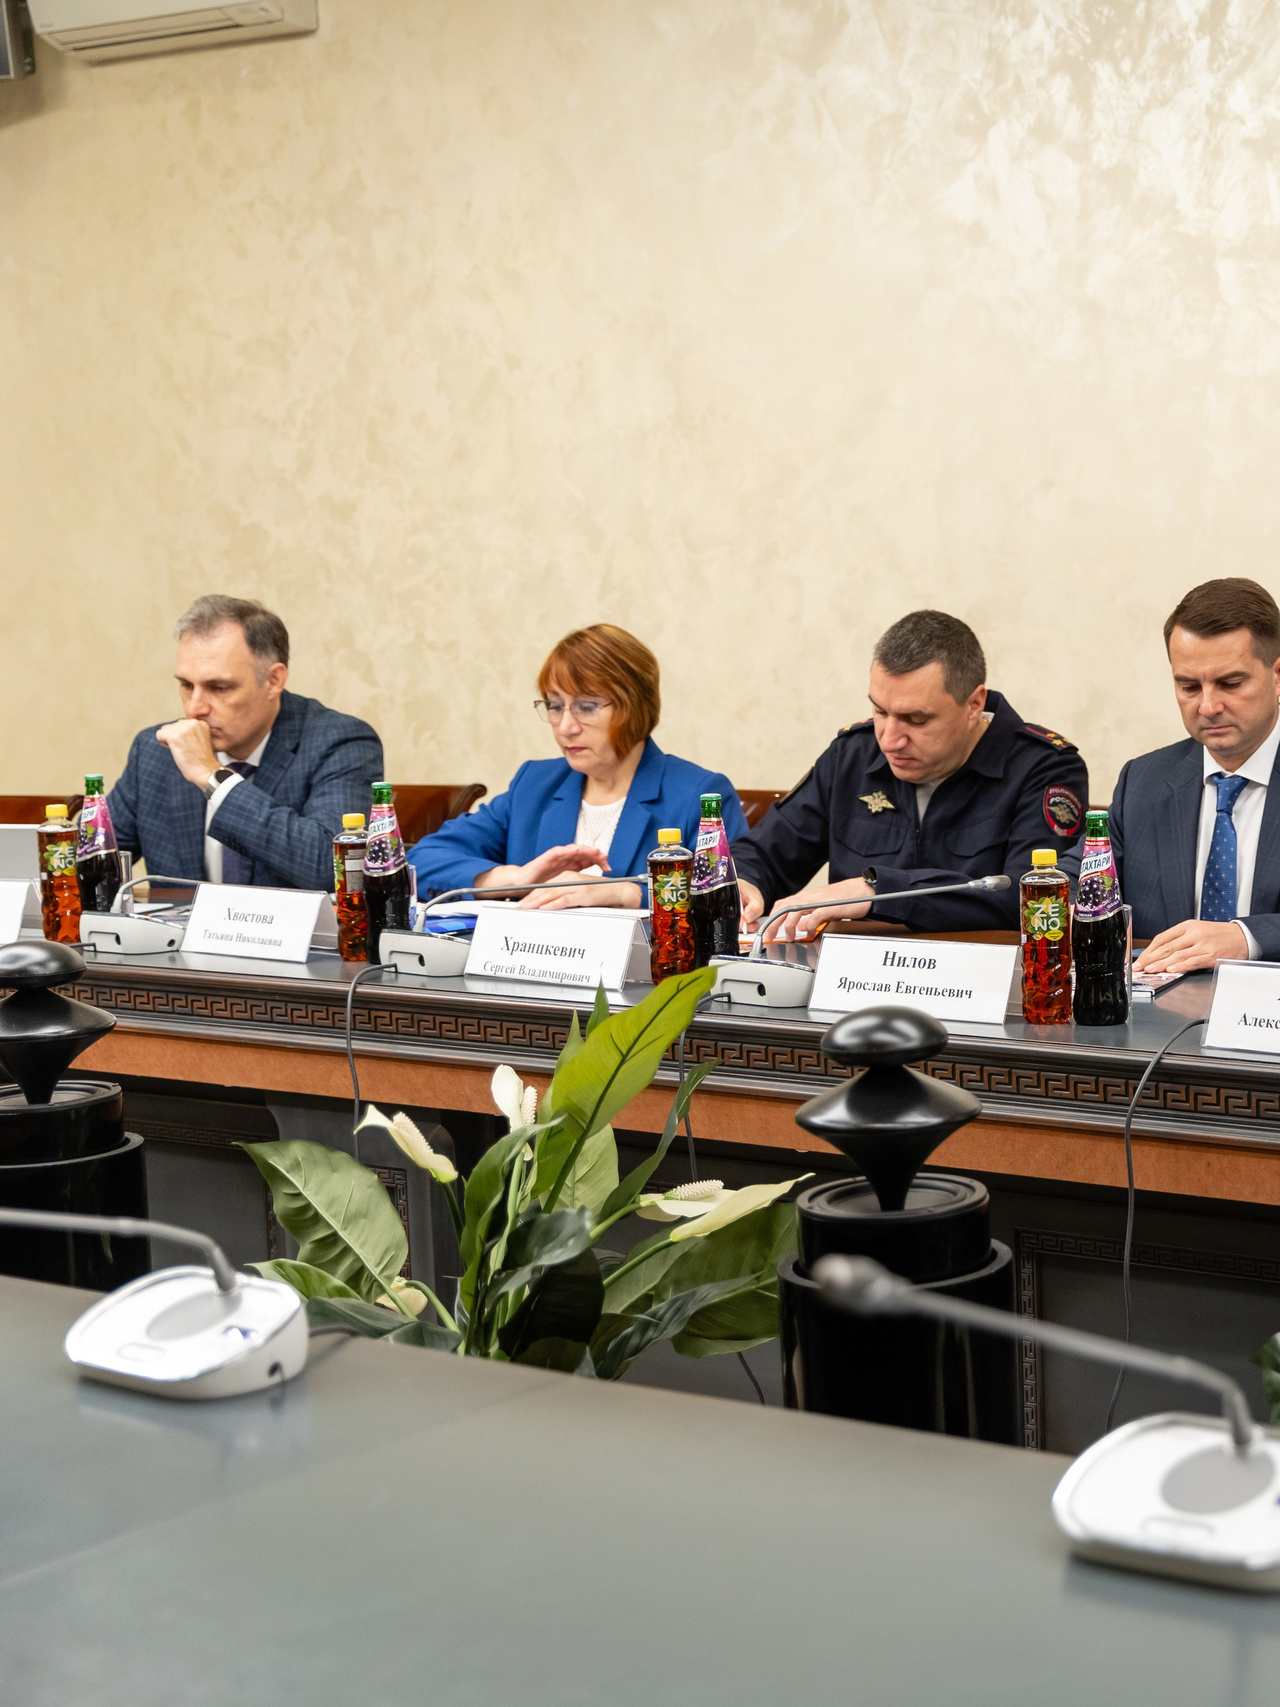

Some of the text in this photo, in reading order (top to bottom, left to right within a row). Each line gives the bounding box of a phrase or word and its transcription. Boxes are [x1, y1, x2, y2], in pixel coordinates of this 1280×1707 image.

[663, 877, 688, 890] ZE
[664, 889, 688, 903] NO
[223, 907, 275, 925] Хвостова
[1033, 903, 1060, 917] ZE
[1034, 917, 1061, 932] NO
[202, 929, 283, 948] Татьяна Николаевна
[500, 936, 586, 960] Хранцкевич
[881, 950, 938, 971] Нилов
[483, 960, 592, 984] Сергей Владимирович
[836, 976, 974, 1000] Ярослав Евгеньевич
